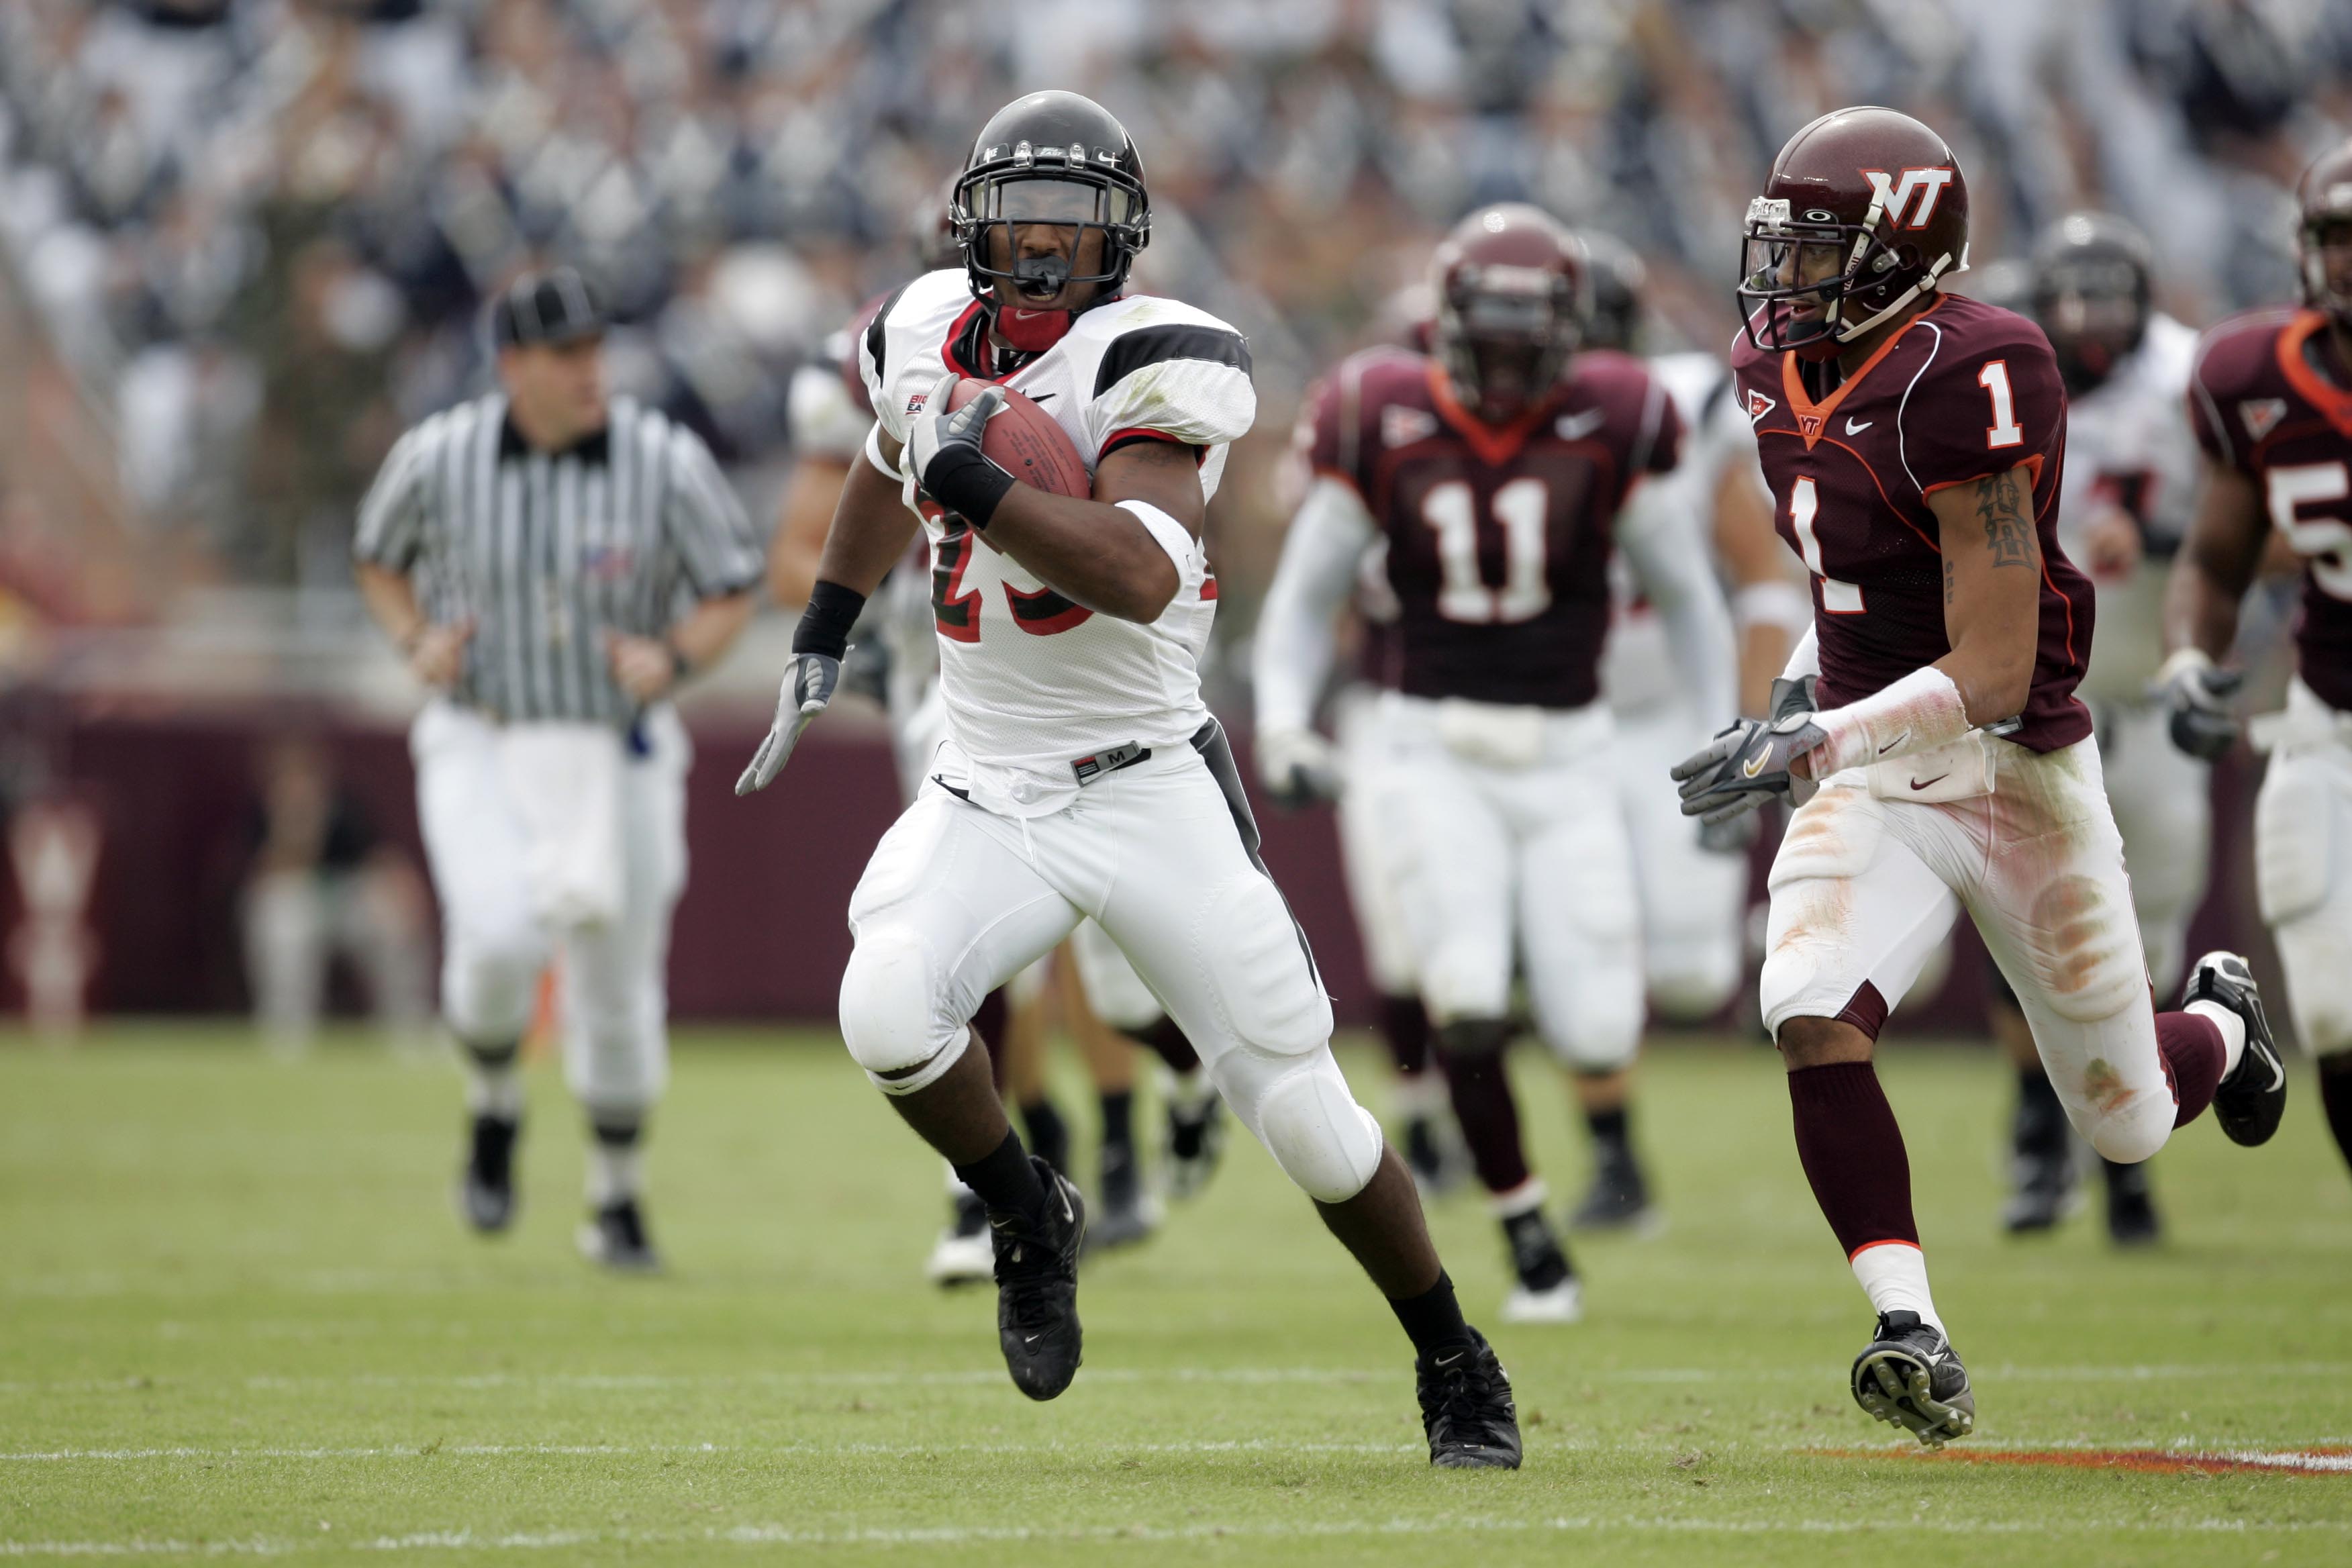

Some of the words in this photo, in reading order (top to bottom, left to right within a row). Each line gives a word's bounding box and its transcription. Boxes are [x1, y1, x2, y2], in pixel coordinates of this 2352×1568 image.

[1859, 166, 1954, 230] VT
[1799, 414, 1821, 436] VT
[1978, 359, 2023, 450] 1
[1422, 477, 1553, 624] 11
[1790, 475, 1867, 614] 1
[1108, 750, 1126, 764] M
